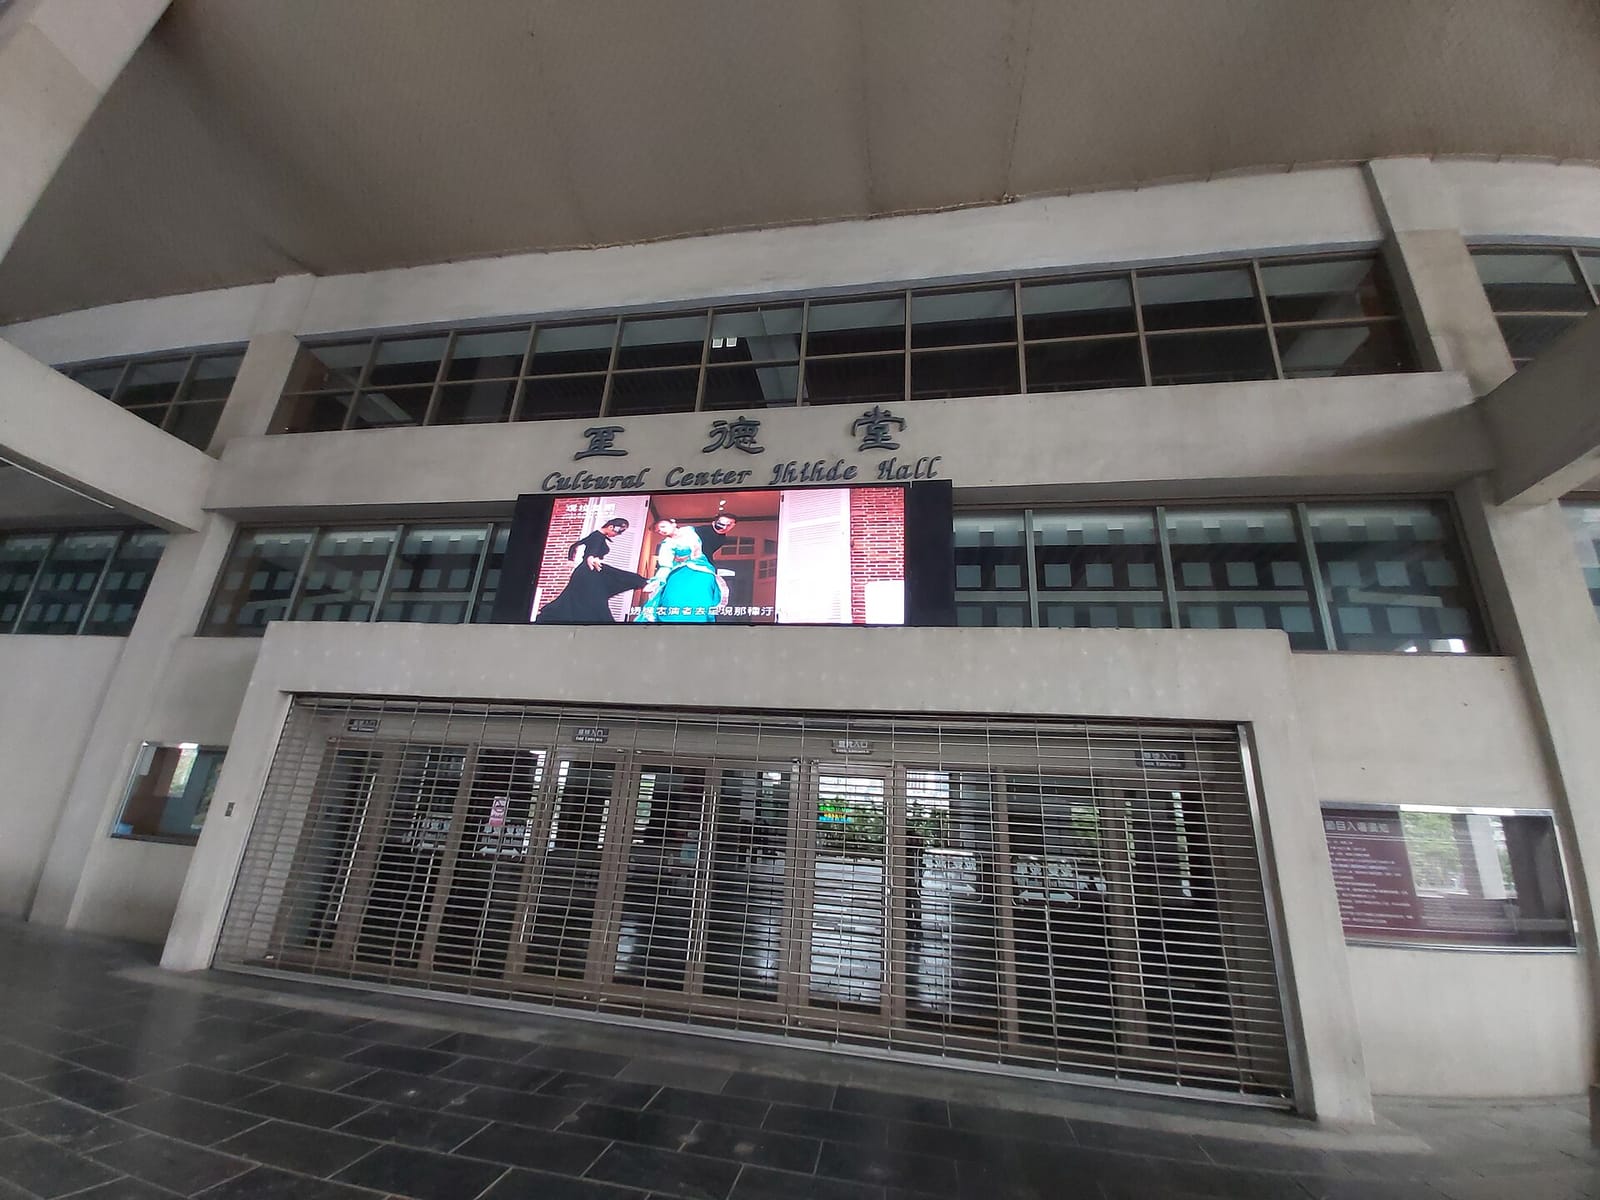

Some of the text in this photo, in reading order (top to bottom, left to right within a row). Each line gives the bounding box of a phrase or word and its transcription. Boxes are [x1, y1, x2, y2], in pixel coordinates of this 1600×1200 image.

[574, 405, 906, 461] 至德堂
[541, 467, 650, 491] Cultural
[665, 466, 753, 488] Center
[877, 455, 942, 481] Hall
